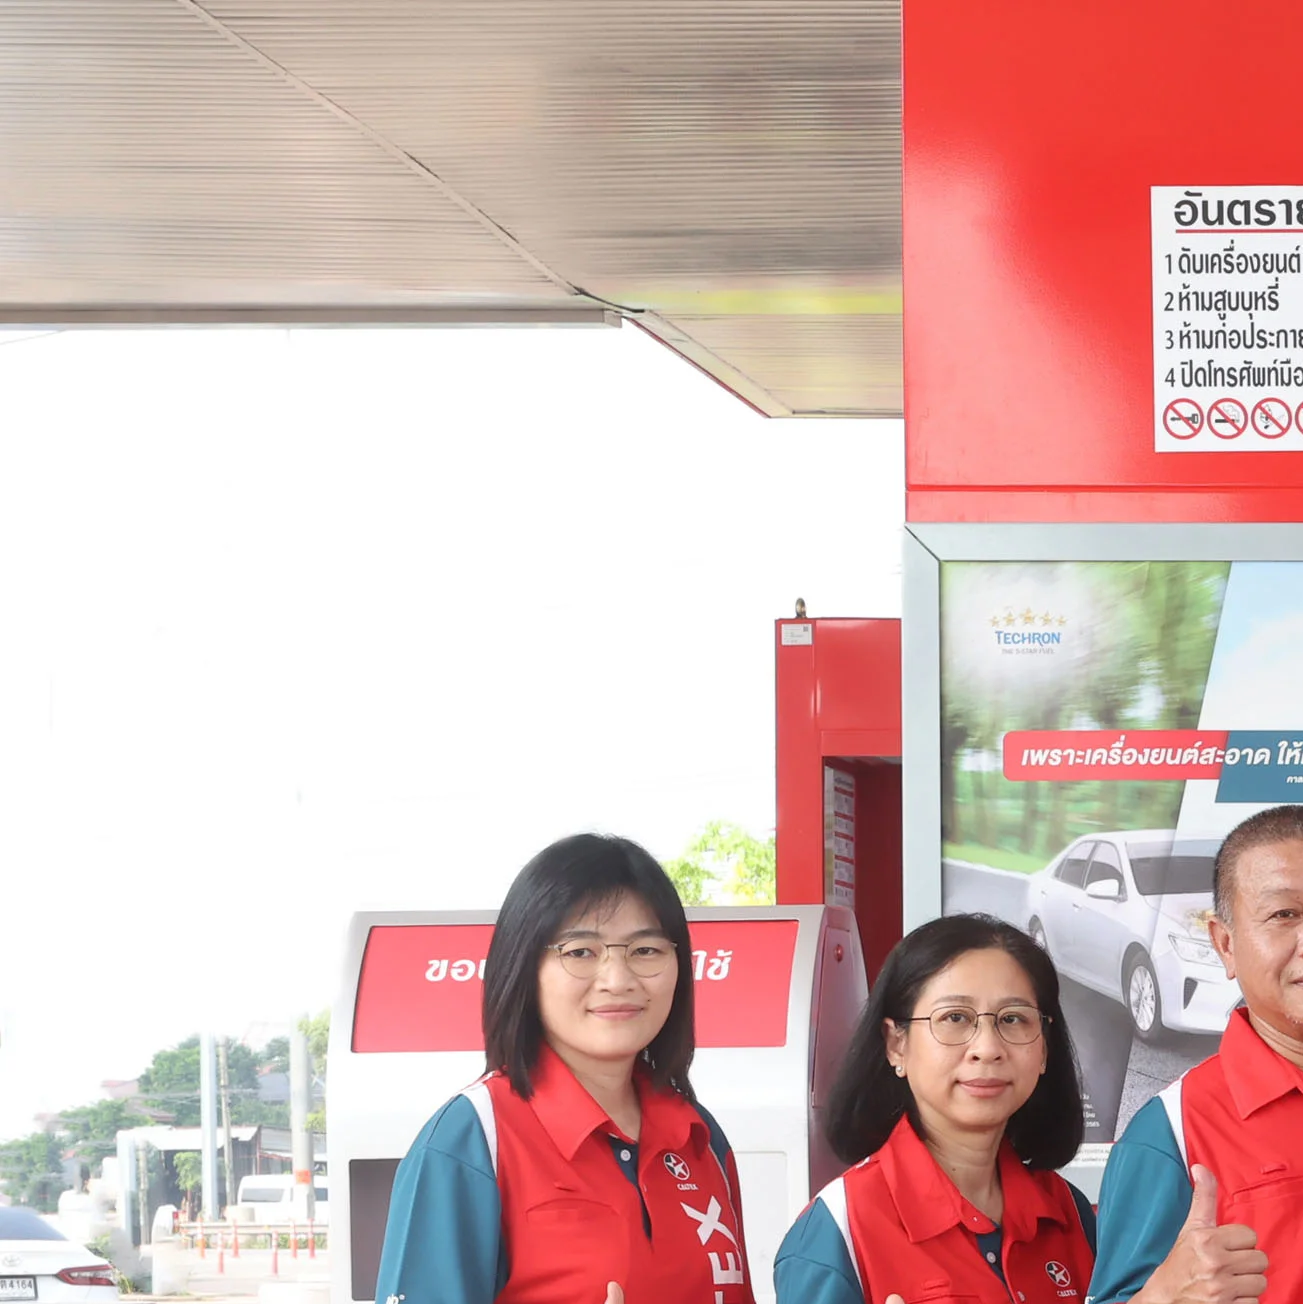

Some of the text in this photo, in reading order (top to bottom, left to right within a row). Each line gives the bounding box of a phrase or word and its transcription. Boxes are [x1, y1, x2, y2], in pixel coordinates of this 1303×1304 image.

[1165, 239, 1301, 274] 1 ดับเครื่องยนต์
[1164, 277, 1279, 320] 2 ห้ามสูบบุหรี่
[1165, 330, 1174, 349] 3
[1164, 367, 1176, 387] 4
[995, 631, 1061, 646] TECHRON
[1021, 734, 1271, 766] เพราะเครื่องยนต์สะอาด
